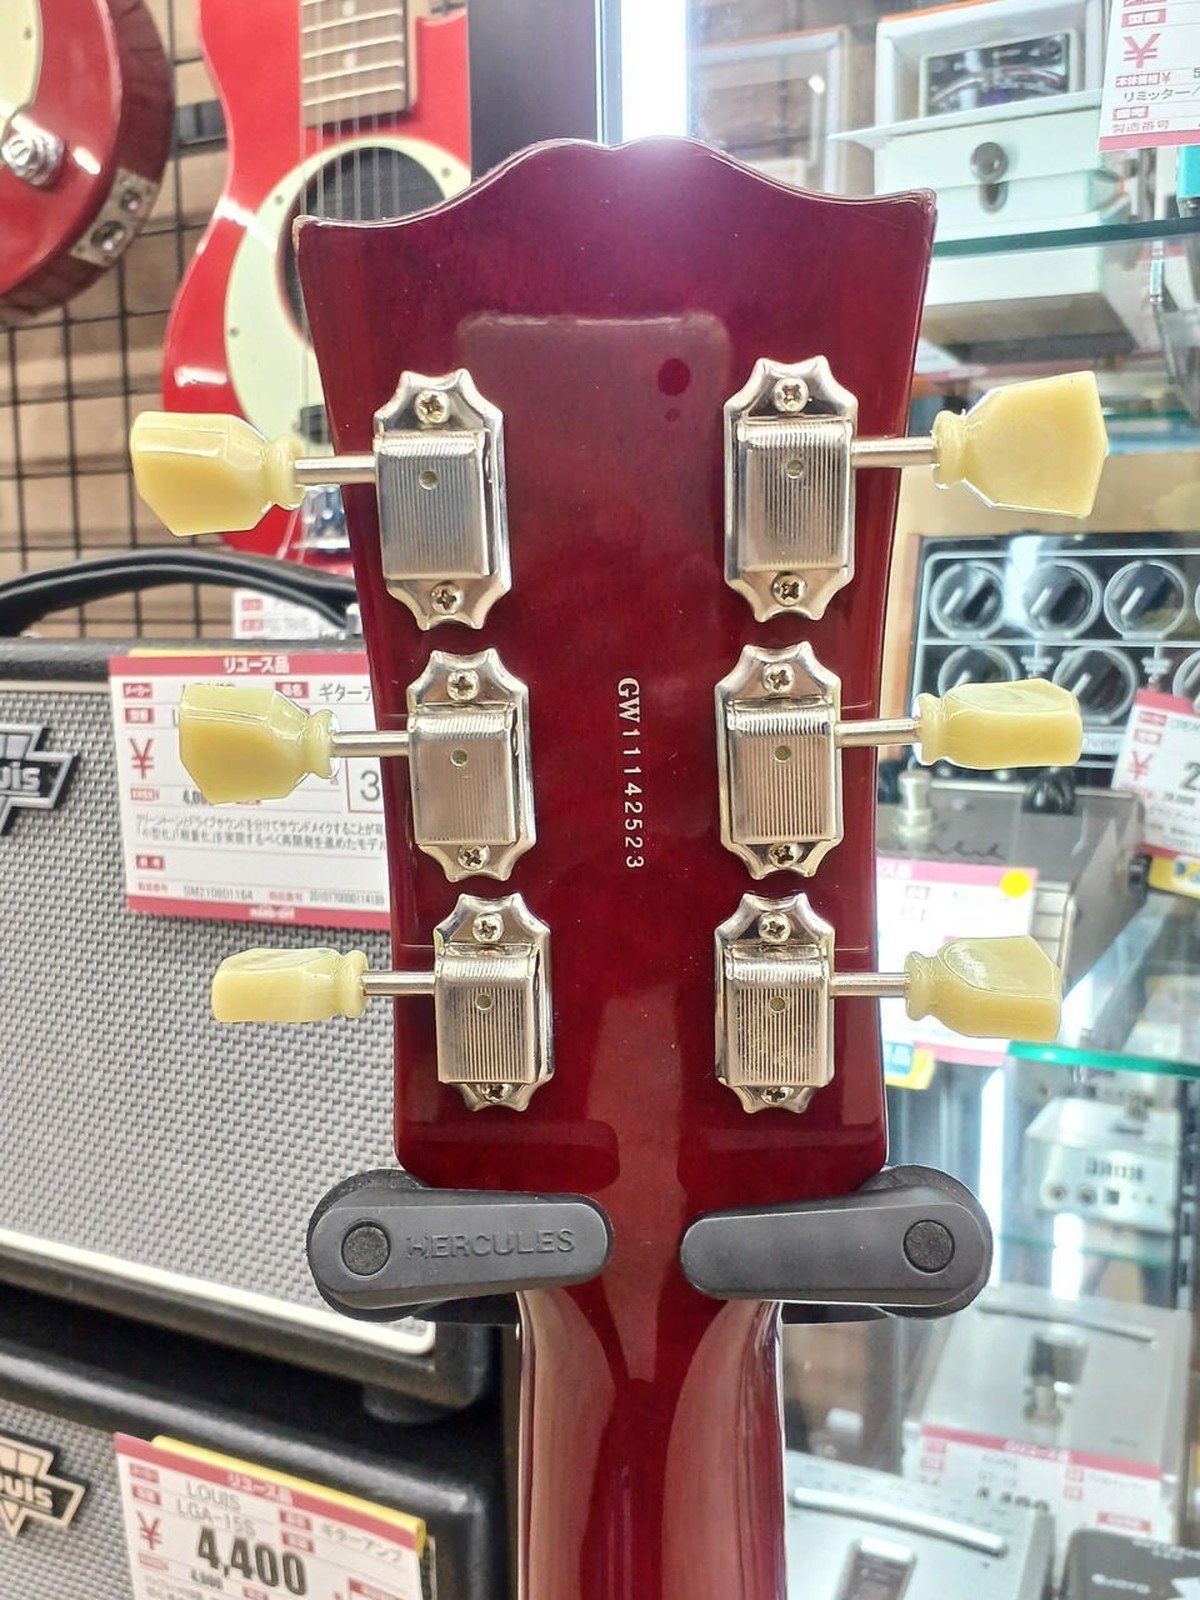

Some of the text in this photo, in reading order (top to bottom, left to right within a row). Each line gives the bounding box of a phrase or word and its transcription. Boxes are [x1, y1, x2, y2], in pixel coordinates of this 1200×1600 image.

[223, 656, 290, 674] リユース品
[617, 676, 645, 868] GW11142523
[406, 1228, 576, 1260] HERCULES
[187, 1479, 241, 1511] LOUIS
[197, 1526, 308, 1596] 4,400
